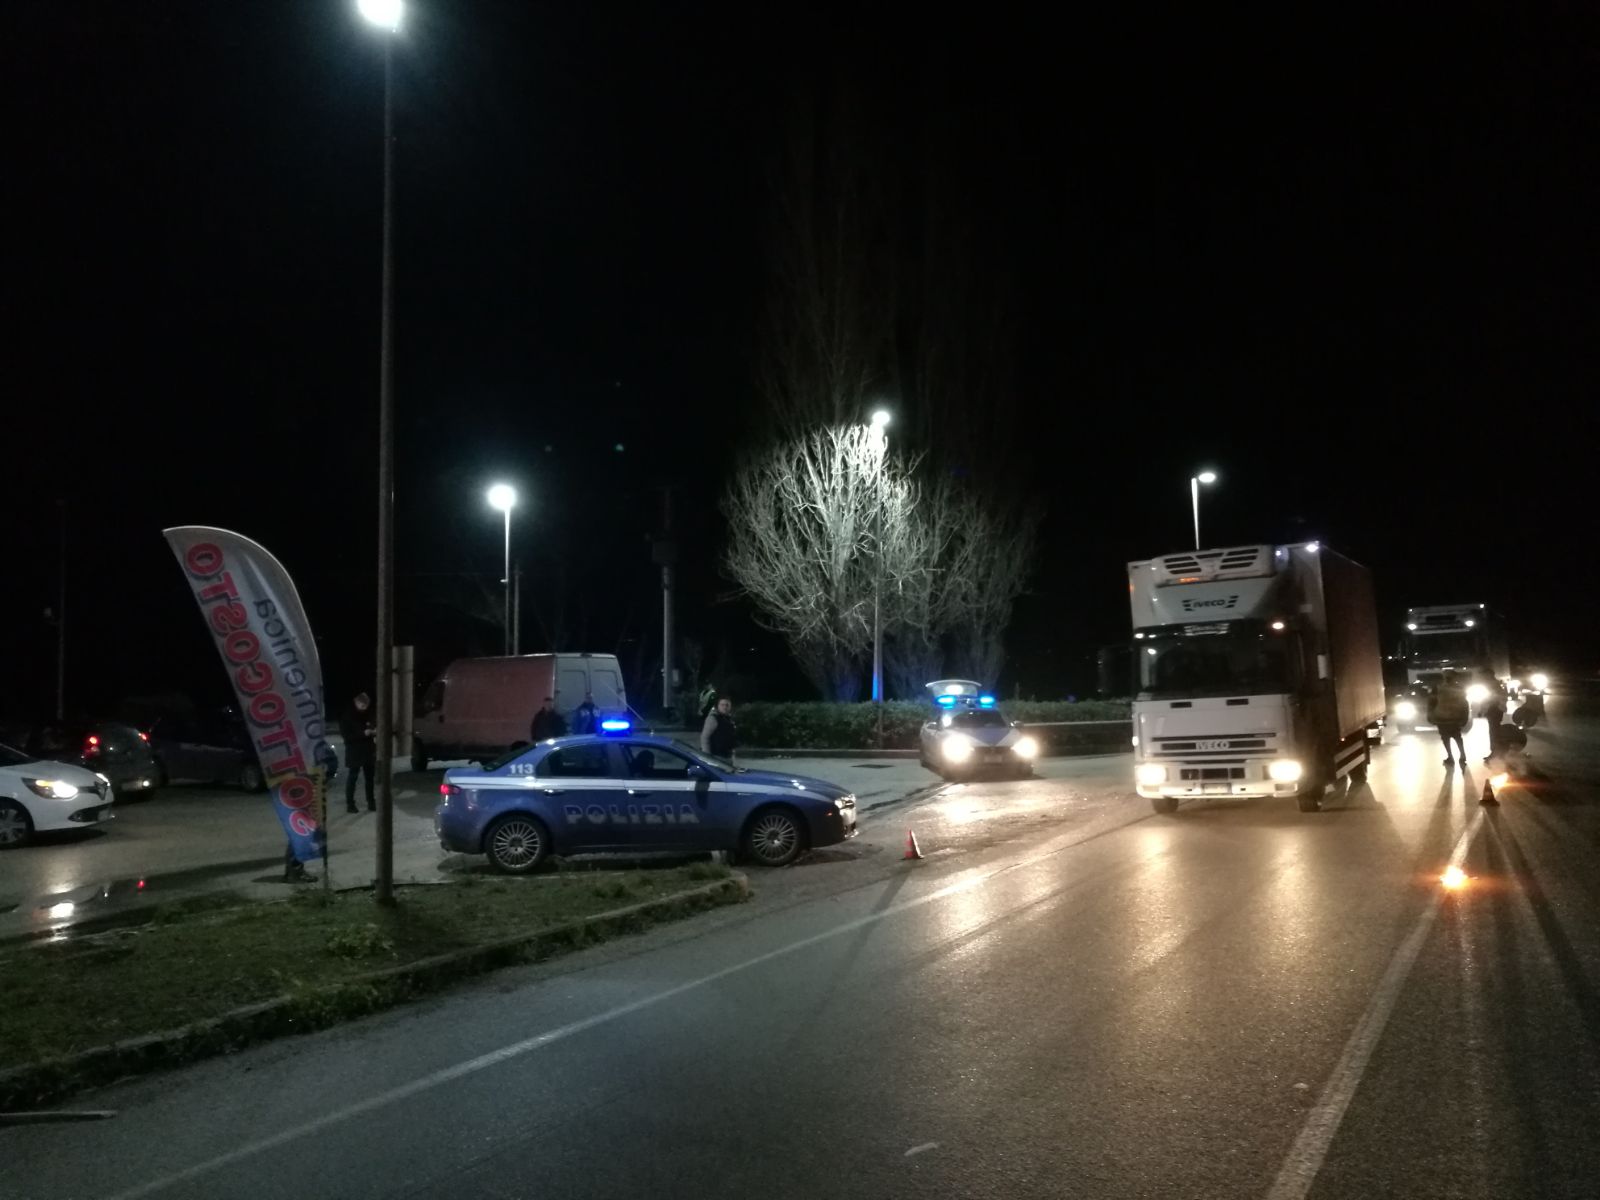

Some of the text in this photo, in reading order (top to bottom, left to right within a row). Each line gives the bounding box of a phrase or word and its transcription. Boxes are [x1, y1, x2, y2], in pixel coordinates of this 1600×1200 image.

[1193, 599, 1225, 609] IVECO
[1196, 741, 1229, 750] IVECO
[510, 763, 534, 774] 113
[563, 803, 700, 823] POLIZIA
